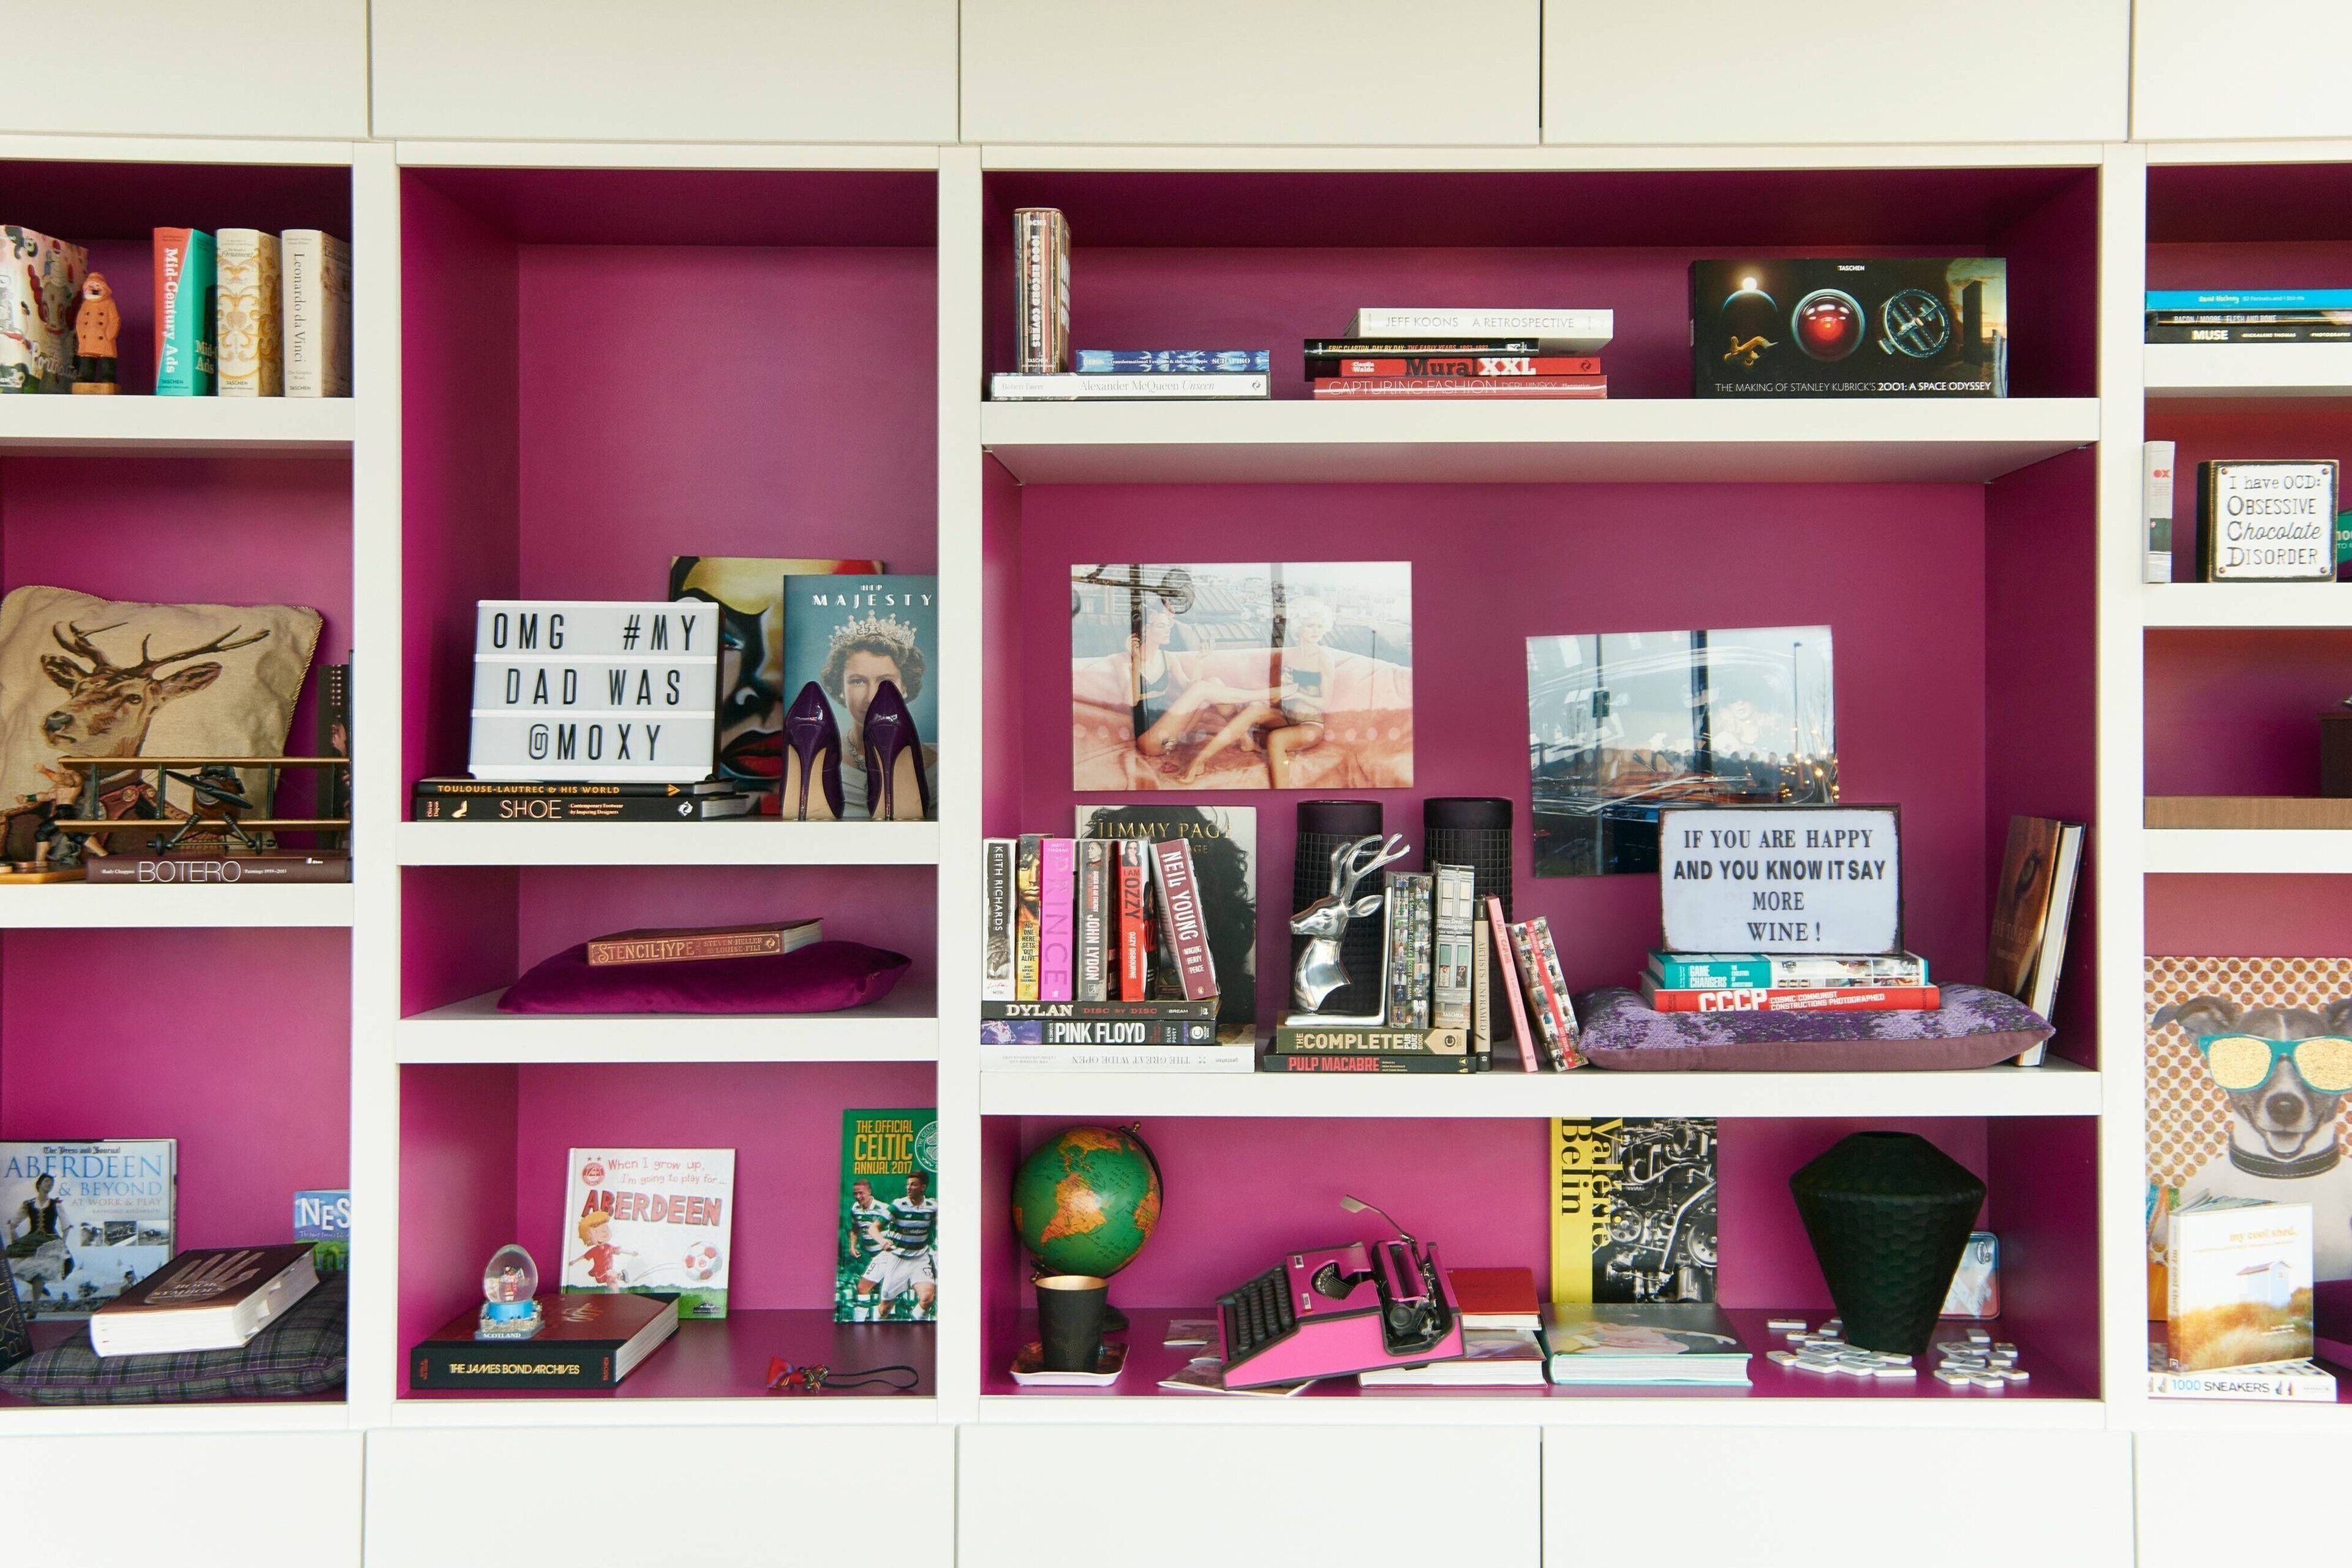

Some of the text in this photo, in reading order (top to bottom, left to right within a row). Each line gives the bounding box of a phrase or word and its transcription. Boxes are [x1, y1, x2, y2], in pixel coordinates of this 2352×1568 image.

[1031, 235, 1041, 263] 1000
[294, 254, 306, 311] Leonardo
[1031, 264, 1041, 306] RECORD
[162, 247, 179, 341] Mid-Century
[2215, 295, 2239, 304] Hockney
[294, 314, 306, 328] da
[1031, 307, 1041, 347] COVERS
[1385, 317, 1574, 328] JEFF KOONS A RETROSPECTIVE
[2192, 330, 2229, 340] MUSE
[294, 331, 306, 362] Vinci
[165, 343, 179, 374] Ads
[1478, 357, 1536, 375] XXL
[1080, 379, 1215, 393] Alexander McQueen Unseen
[1329, 380, 1496, 396] CAPTURING FASHION
[1715, 382, 1991, 392] THE MAKING OF STANLEY KUBRICK'S 2001: A SPACE ODYSSEY
[2230, 475, 2321, 489] I have OCD:
[2227, 495, 2316, 516] OBSESSIVE
[2227, 521, 2323, 541] Chocolate
[2226, 546, 2318, 567] DISORDER
[812, 594, 932, 609] MAJESTY
[494, 612, 696, 652] OMG #MY
[507, 668, 680, 706] DAD WAS
[529, 723, 661, 761] @MOXY
[438, 785, 544, 793] TOULOUSE-LAUTREC
[499, 799, 562, 819] SHOE
[1098, 821, 1232, 839] JIMMY PAGE
[1684, 829, 1873, 848] IF YOU ARE HAPPY
[138, 860, 242, 883] BOTERO
[1128, 868, 1140, 876] AM
[1674, 860, 1886, 880] AND YOU KNOW IT SAY
[993, 845, 1003, 932] KEITH RICHARDS
[1125, 877, 1141, 919] OZZY
[1163, 850, 1199, 941] NEIL YOUNG
[1752, 891, 1804, 911] MORE
[1044, 858, 1069, 986] PRINCE
[1086, 914, 1100, 944] JOHN
[1747, 922, 1809, 942] WINE
[1085, 946, 1100, 981] LYDON
[1127, 931, 1137, 980] OZZY OSBOURNE
[1188, 965, 1205, 974] PEACE
[1689, 965, 1710, 976] GAME
[1478, 941, 1487, 1031] ARTISTS UNFRAMED
[1689, 976, 1727, 988] CHANGERS
[1699, 989, 1768, 1012] CCCP
[1770, 991, 1838, 1003] COSMIC COMMUNIST
[1770, 993, 1885, 1011] CONSTRUCTIONS PHOTOGRAPHED
[1005, 1004, 1073, 1017] DYLAN
[1054, 1022, 1092, 1043] PINK
[1095, 1022, 1145, 1044] FLOYD
[1303, 1033, 1404, 1050] COMPLETE
[1072, 1055, 1191, 1065] THE GREAT WIDE OPEN
[1289, 1057, 1319, 1072] PULP
[1321, 1057, 1379, 1071] MACABRE
[856, 1119, 914, 1133] THE OFFICIAL
[58, 1146, 78, 1155] Press
[92, 1146, 121, 1155] Journal
[854, 1133, 914, 1161] CELTIC
[4, 1155, 165, 1179] ABERDEEN
[608, 1158, 638, 1170] When
[654, 1160, 681, 1170] grow
[854, 1161, 913, 1175] ANNUAL 2017
[1561, 1117, 1593, 1216] Belin
[620, 1173, 700, 1185] I'm going to play
[58, 1182, 163, 1196] & BEYOND
[71, 1199, 83, 1207] AT
[89, 1198, 122, 1207] WORK
[136, 1197, 161, 1207] PLAY
[581, 1189, 723, 1227] ABERDEEN
[2229, 1232, 2245, 1242] my
[450, 1363, 580, 1374] THE JAMES BOND ARCHIVES
[2171, 1378, 2270, 1393] 1000 SNEAKERS
